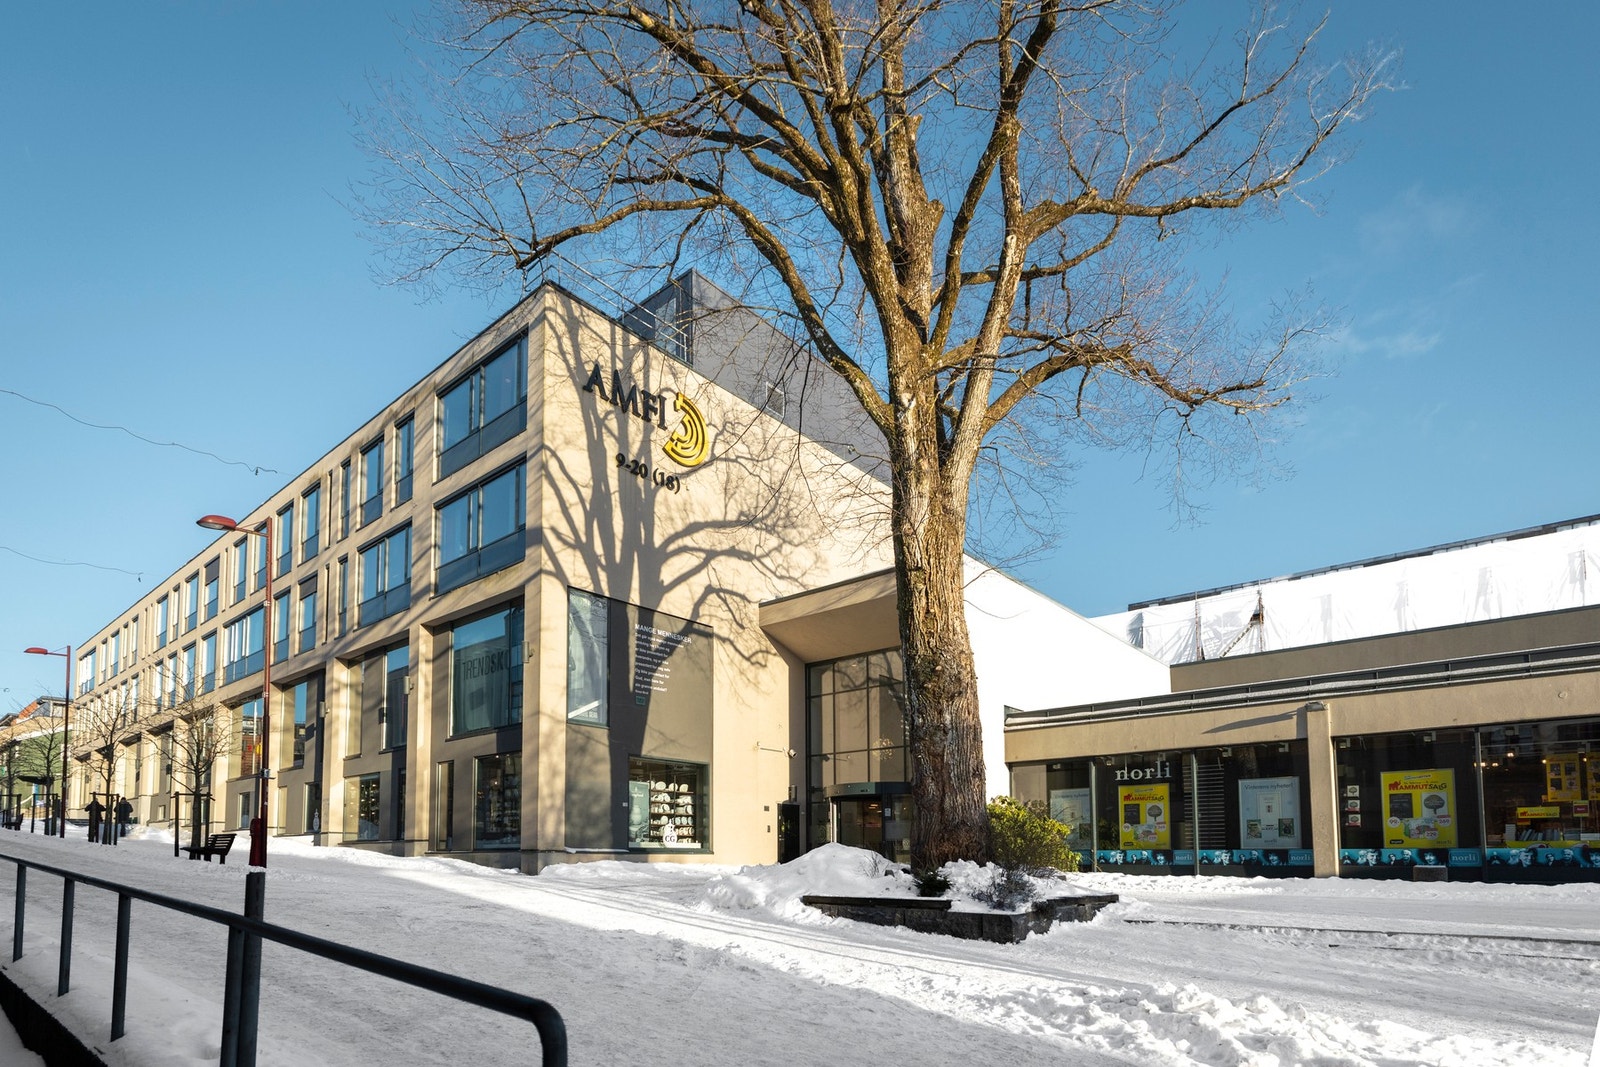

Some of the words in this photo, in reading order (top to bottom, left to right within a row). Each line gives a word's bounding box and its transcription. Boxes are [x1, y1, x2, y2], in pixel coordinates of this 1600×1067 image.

[582, 363, 668, 431] AMFI
[615, 452, 649, 479] 9-20
[653, 467, 681, 495] (18)
[635, 623, 657, 635] MANGE
[657, 629, 692, 644] MENNESKER
[1115, 760, 1172, 781] norli
[1175, 853, 1193, 861] norli
[1291, 853, 1311, 861] norli
[1451, 853, 1476, 861] norli
